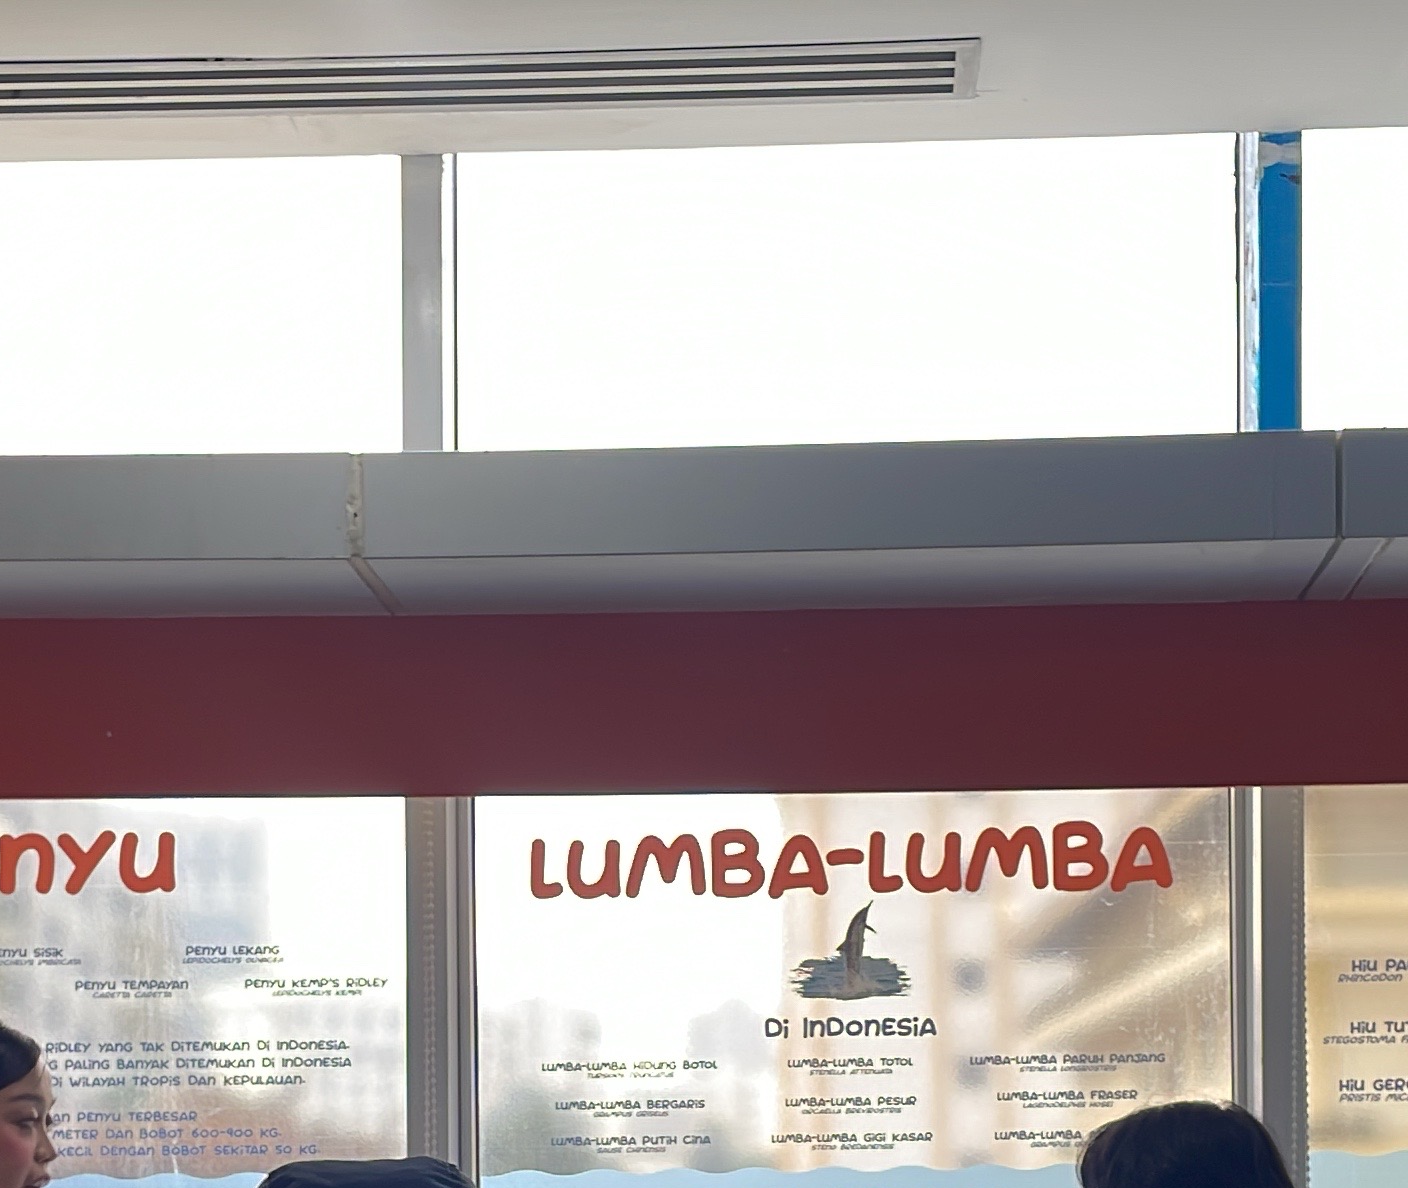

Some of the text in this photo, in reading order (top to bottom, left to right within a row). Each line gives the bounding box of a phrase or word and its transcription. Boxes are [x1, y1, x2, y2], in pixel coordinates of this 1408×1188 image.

[529, 821, 1173, 899] LUMBA-LUMBA
[1352, 958, 1377, 972] HIU
[1350, 1021, 1376, 1034] HIU
[1339, 1078, 1365, 1092] HIU
